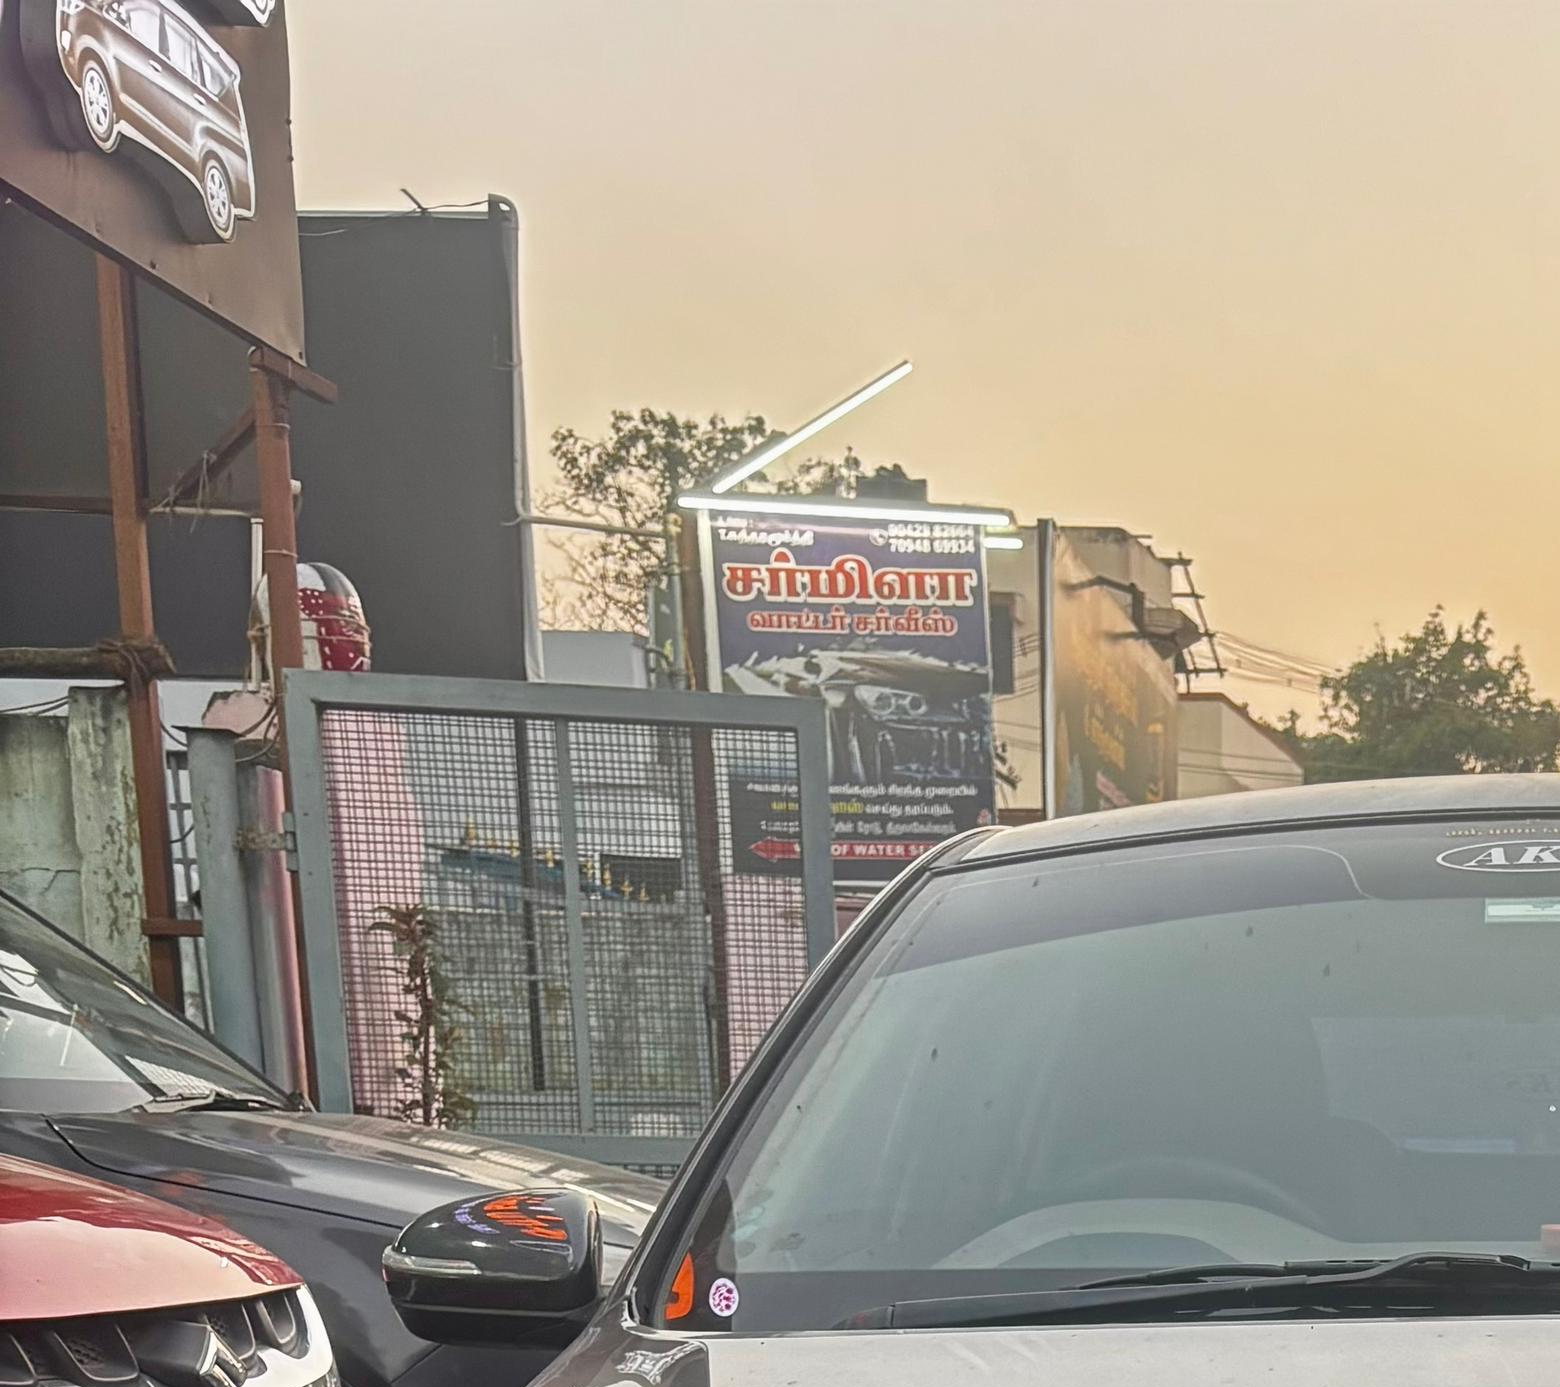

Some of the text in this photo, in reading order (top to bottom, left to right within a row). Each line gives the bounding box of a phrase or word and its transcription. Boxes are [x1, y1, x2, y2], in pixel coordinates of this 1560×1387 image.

[724, 548, 976, 604] சர்மிளா
[747, 607, 958, 635] வாட்டர் சர்வீஸ்
[853, 844, 905, 855] WATER
